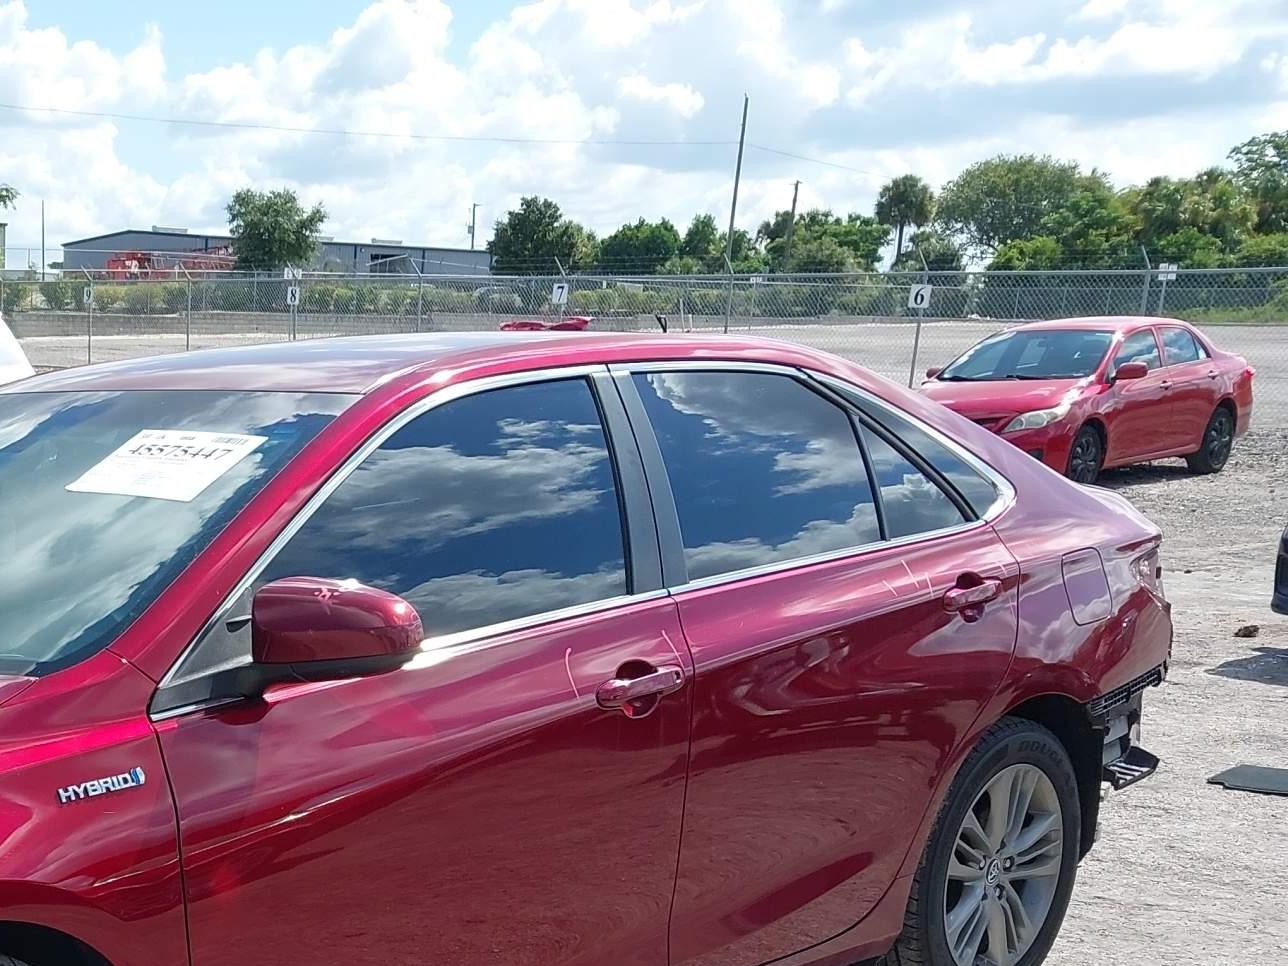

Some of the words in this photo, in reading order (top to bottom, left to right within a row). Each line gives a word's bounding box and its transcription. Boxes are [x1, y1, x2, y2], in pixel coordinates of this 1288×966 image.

[914, 286, 926, 305] 6
[128, 444, 233, 460] 45575447
[57, 771, 134, 804] HYBRID
